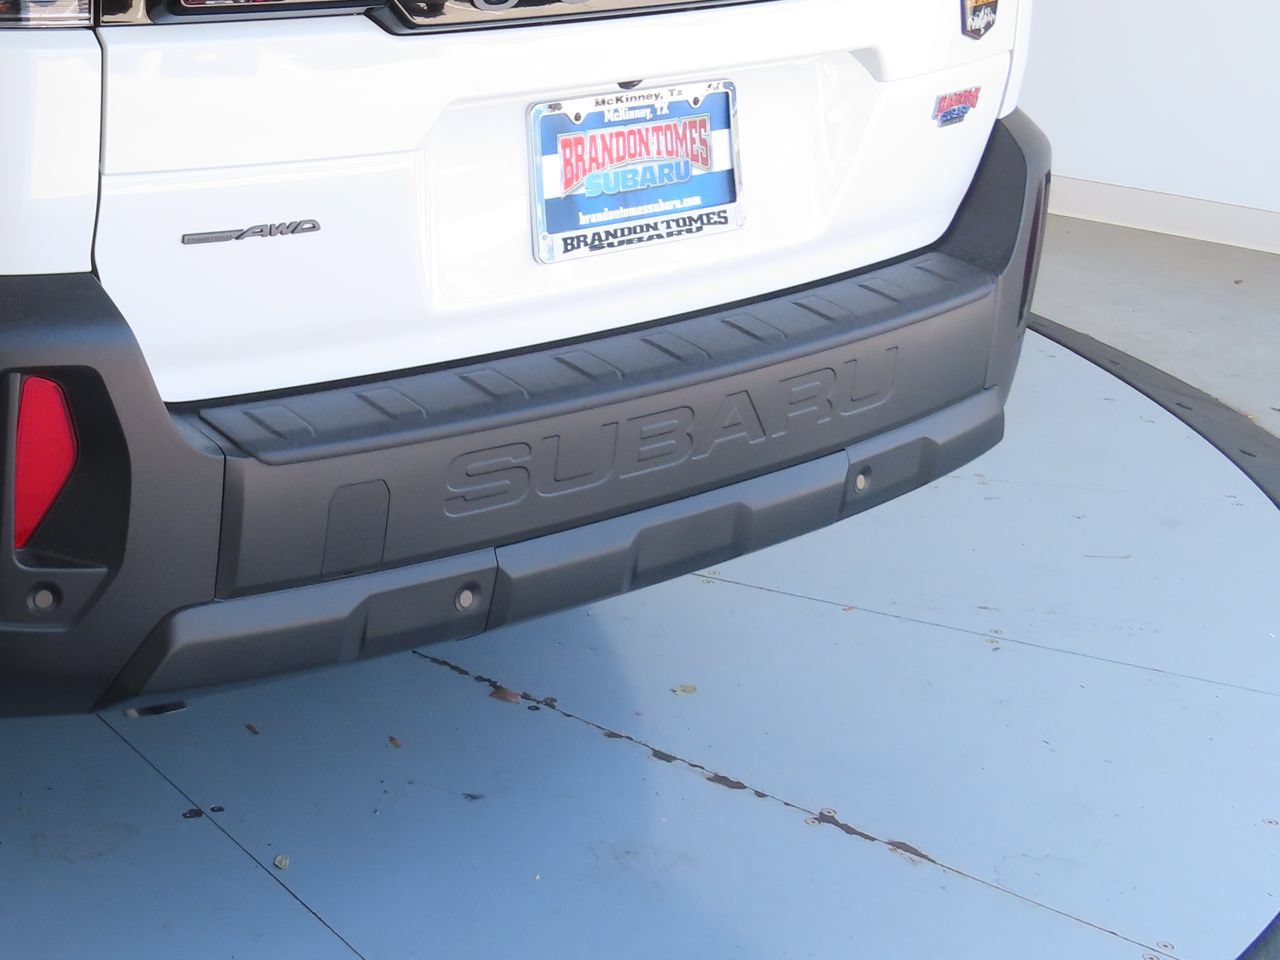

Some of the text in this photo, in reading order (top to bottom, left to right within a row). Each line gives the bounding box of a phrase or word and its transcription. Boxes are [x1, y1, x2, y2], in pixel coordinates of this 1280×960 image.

[594, 91, 663, 108] McKinney,
[584, 160, 691, 197] SUBARU
[234, 219, 321, 240] AWD
[562, 209, 729, 254] BRANDON TOMES
[588, 226, 704, 252] SUBARU
[443, 345, 899, 518] SUBARU
